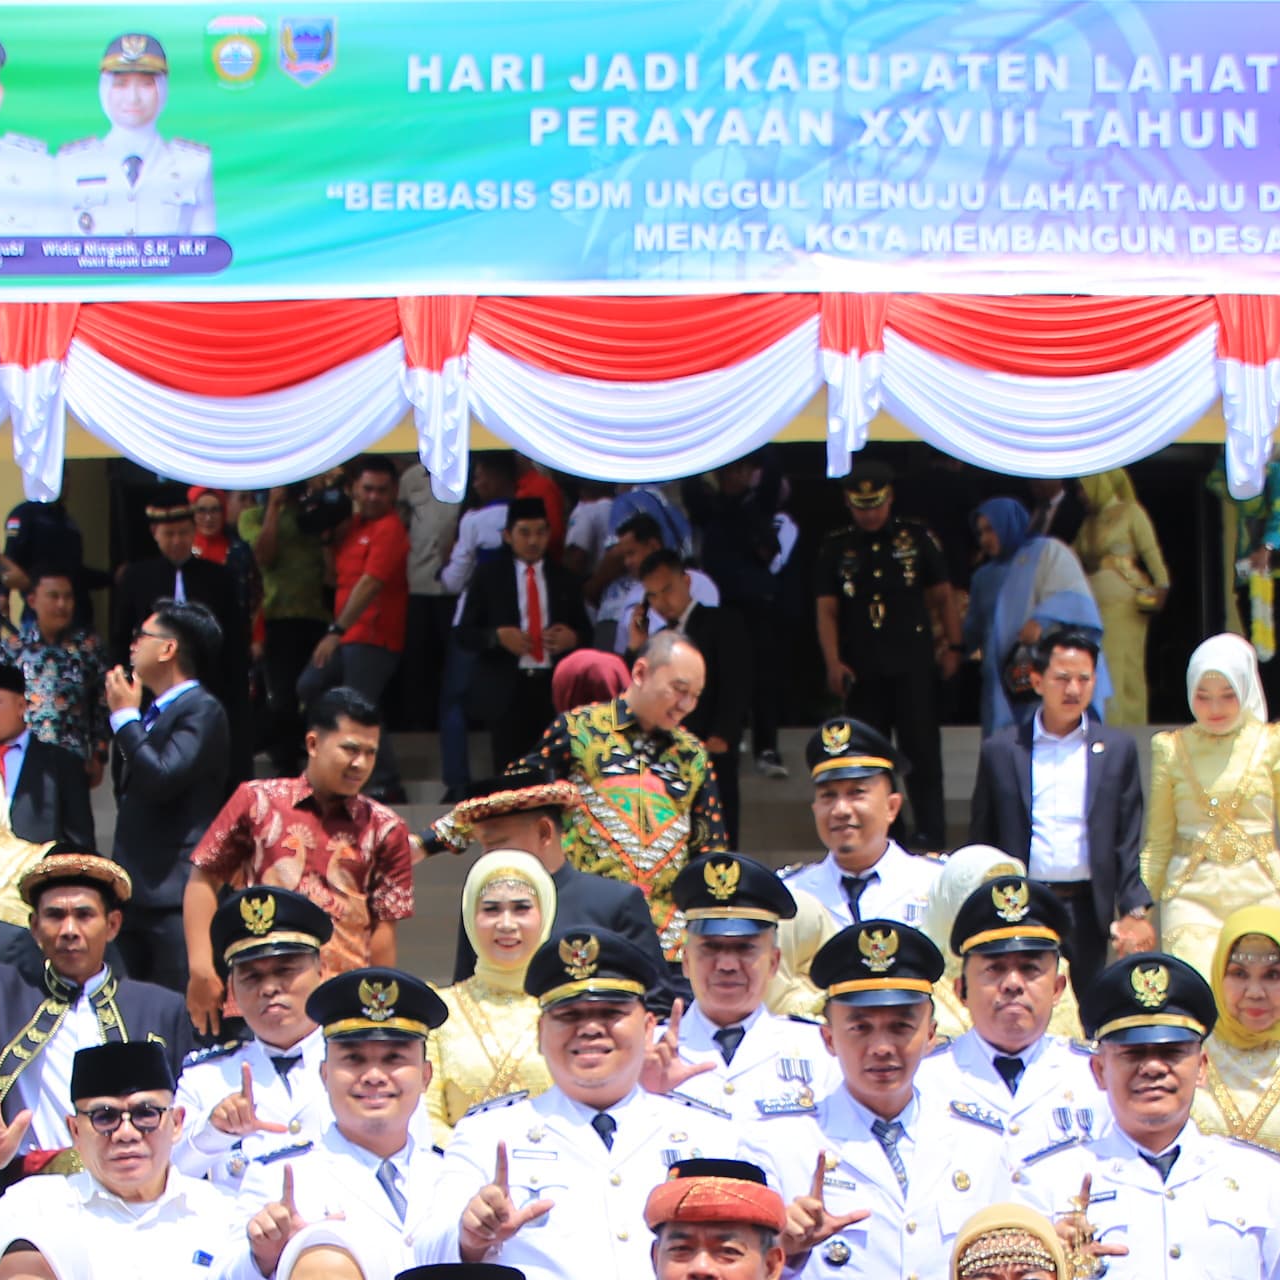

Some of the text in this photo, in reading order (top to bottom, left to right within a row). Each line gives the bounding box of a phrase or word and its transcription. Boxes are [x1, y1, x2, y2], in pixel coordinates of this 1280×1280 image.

[407, 55, 545, 93] HARI
[569, 55, 698, 93] JADI
[725, 53, 1068, 93] KABUPATEN
[1095, 54, 1279, 93] LAHAT
[531, 108, 834, 147] PERAYAAN
[861, 108, 1038, 148] XXVIII
[1062, 110, 1258, 149] TAHUN
[327, 181, 537, 211] “BERBASIS
[550, 181, 631, 210] SDM
[646, 180, 808, 210] UNGGUL
[822, 181, 985, 211] MENUJU
[1002, 182, 1123, 211] LAHAT
[1137, 183, 1245, 212] MAJU
[42, 240, 80, 257] Widia
[634, 225, 792, 253] MENATA
[805, 225, 907, 253] KOTA
[921, 225, 1175, 253] MEMBANGUN
